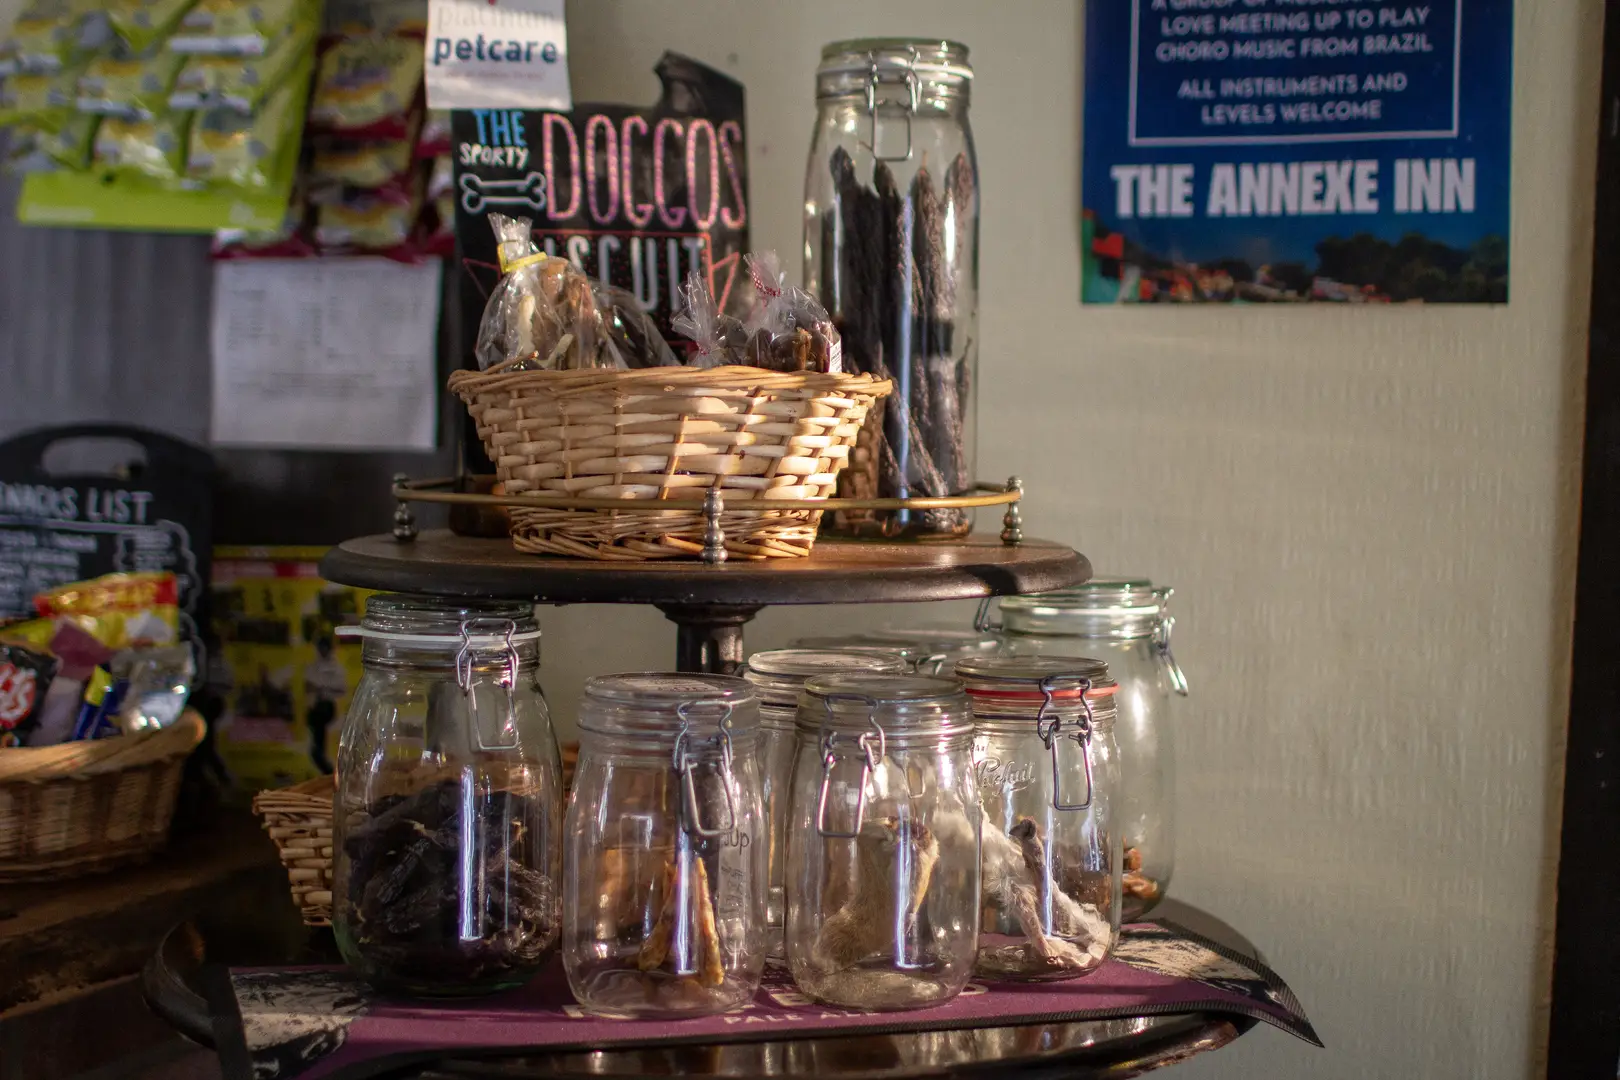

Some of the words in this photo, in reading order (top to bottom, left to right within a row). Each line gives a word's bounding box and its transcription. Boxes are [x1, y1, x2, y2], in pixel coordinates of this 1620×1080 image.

[1161, 14, 1215, 36] LOVE
[1219, 12, 1310, 33] MEETING
[1314, 10, 1341, 31] UP
[1346, 9, 1374, 29] TO
[1378, 6, 1430, 27] PLAY
[434, 33, 557, 66] petcare
[1155, 40, 1229, 62] CHORO
[1234, 38, 1295, 59] MUSIC
[1300, 36, 1358, 57] FROM
[1363, 33, 1432, 53] BRAZIL
[1178, 79, 1216, 99] ALL
[1220, 75, 1358, 97] INSTRUMENTS
[1362, 73, 1407, 92] AND
[1202, 103, 1276, 125] LEVELS
[1280, 100, 1382, 122] WELCOME
[471, 109, 528, 147] THE
[459, 141, 529, 170] SPORTY
[543, 112, 746, 230] DOGGOS
[1110, 163, 1194, 218] THE
[1207, 160, 1379, 217] ANNEXE
[1394, 158, 1475, 213] INN
[86, 486, 153, 525] LIST
[723, 1012, 804, 1025] PALE
